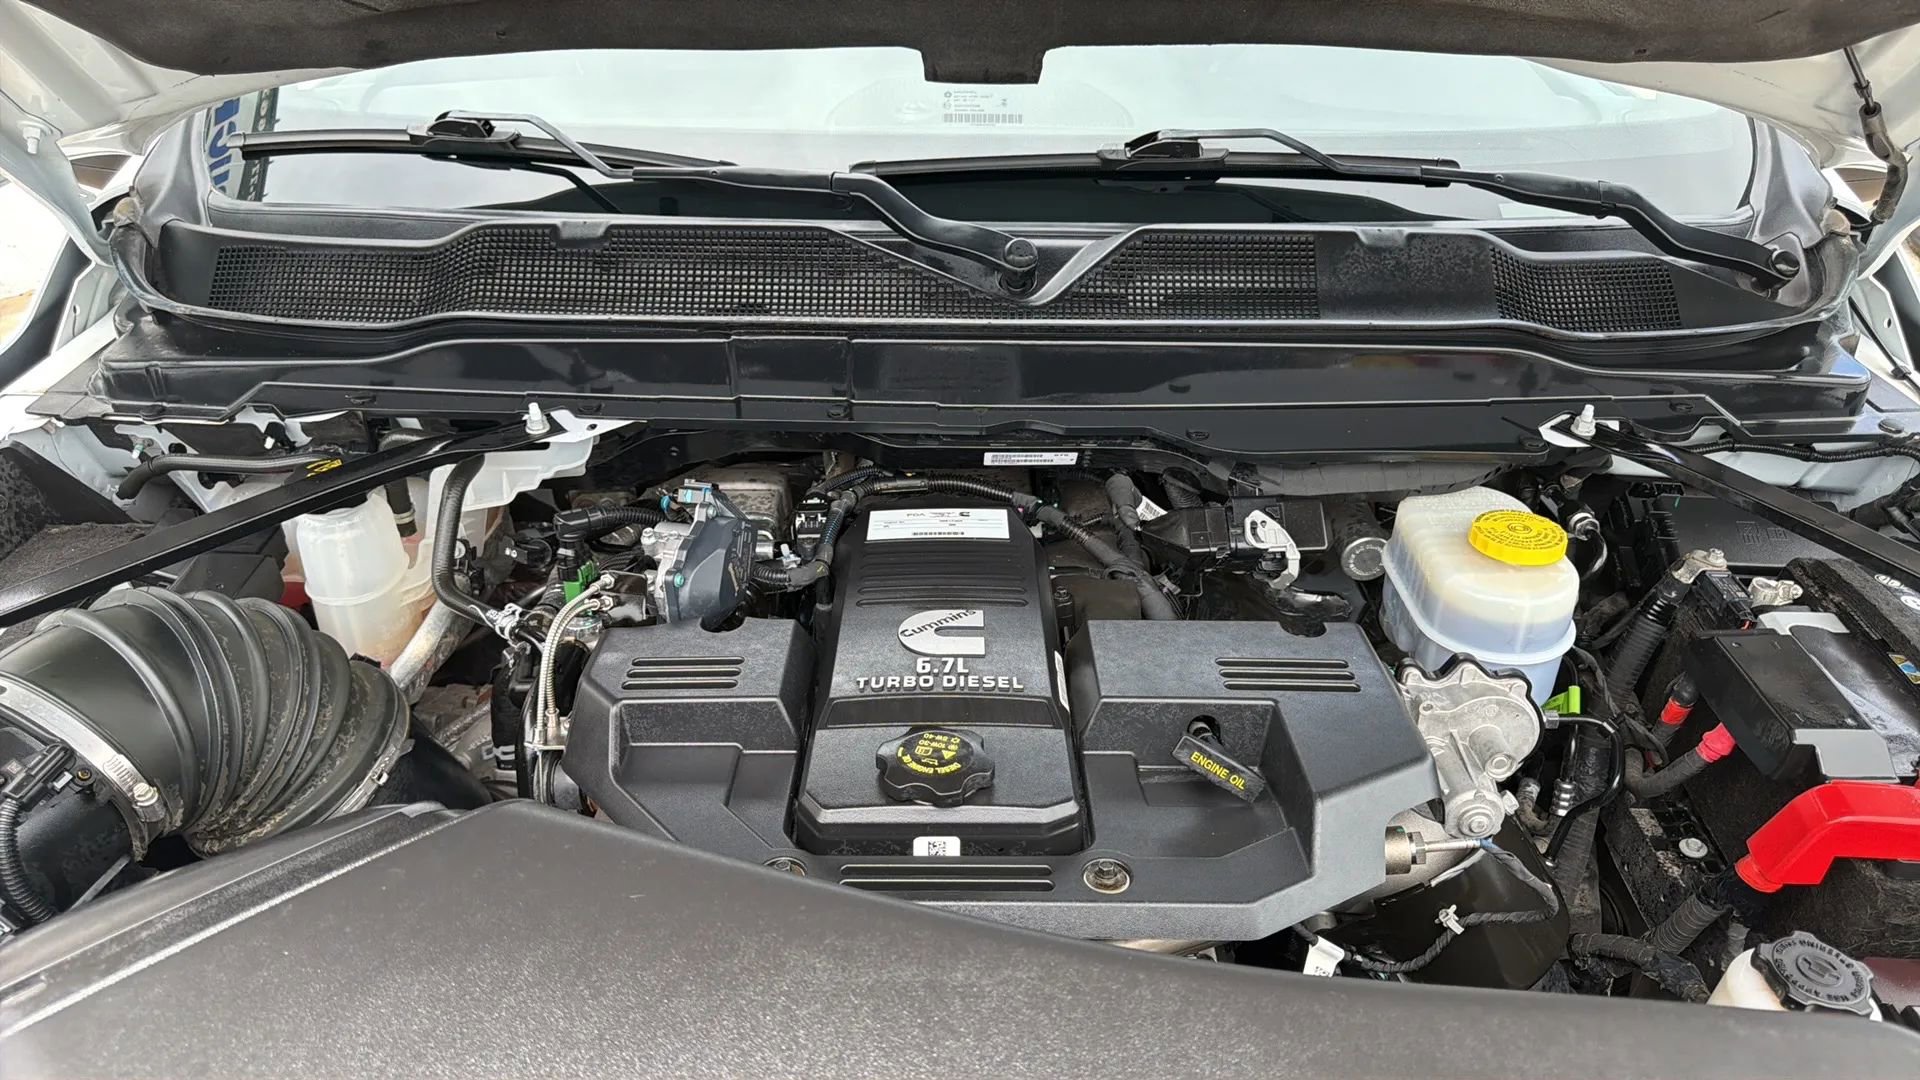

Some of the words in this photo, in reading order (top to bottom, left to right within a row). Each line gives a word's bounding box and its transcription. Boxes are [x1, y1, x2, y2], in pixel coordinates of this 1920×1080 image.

[899, 609, 977, 638] Cummins
[916, 657, 970, 676] 6.7L
[856, 675, 935, 691] TURBO
[942, 675, 1025, 691] DIESEL
[935, 761, 962, 774] DIESEL
[1190, 751, 1230, 779] ENGINE
[1229, 774, 1246, 790] OIL
